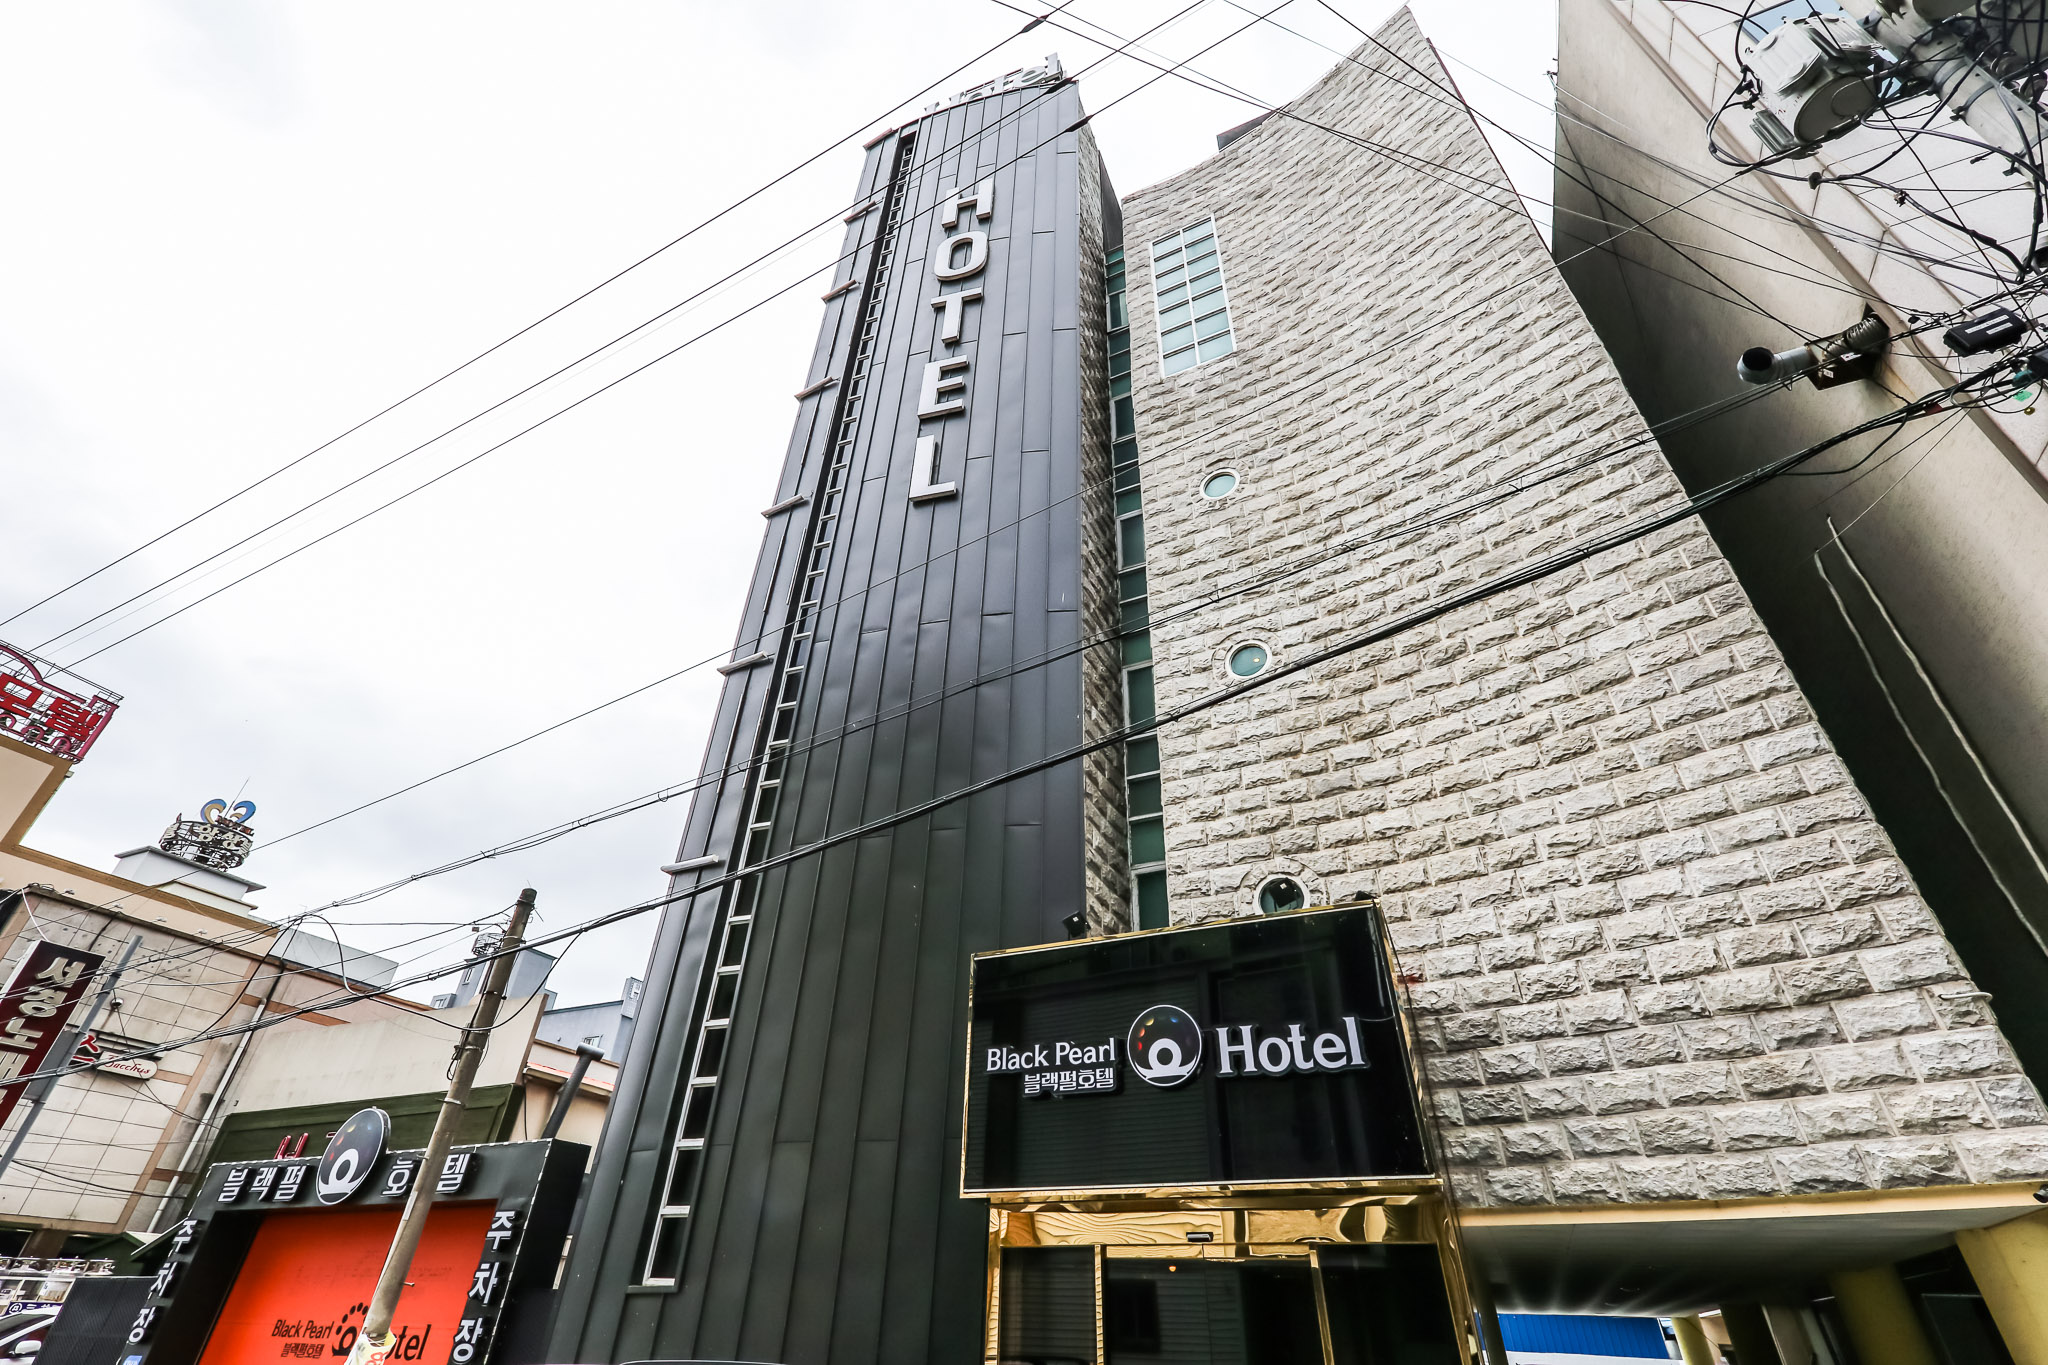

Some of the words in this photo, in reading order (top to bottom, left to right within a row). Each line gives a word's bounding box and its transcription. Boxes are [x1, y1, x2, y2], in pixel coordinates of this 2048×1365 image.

[923, 52, 1063, 108] tel
[909, 176, 994, 502] HOTEL
[986, 1044, 1049, 1072] Black
[1055, 1037, 1116, 1066] Pearl
[1216, 1016, 1366, 1074] Hotel
[1023, 1067, 1114, 1094] 블랙펄호텔
[218, 1165, 308, 1203] 블랙펄
[128, 1219, 198, 1343] 주차장
[451, 1210, 516, 1362] 주차장
[271, 1319, 303, 1338] Black
[302, 1320, 335, 1339] Pearl
[385, 1324, 432, 1361] tel
[280, 1342, 325, 1359] 블랙펄호텔
